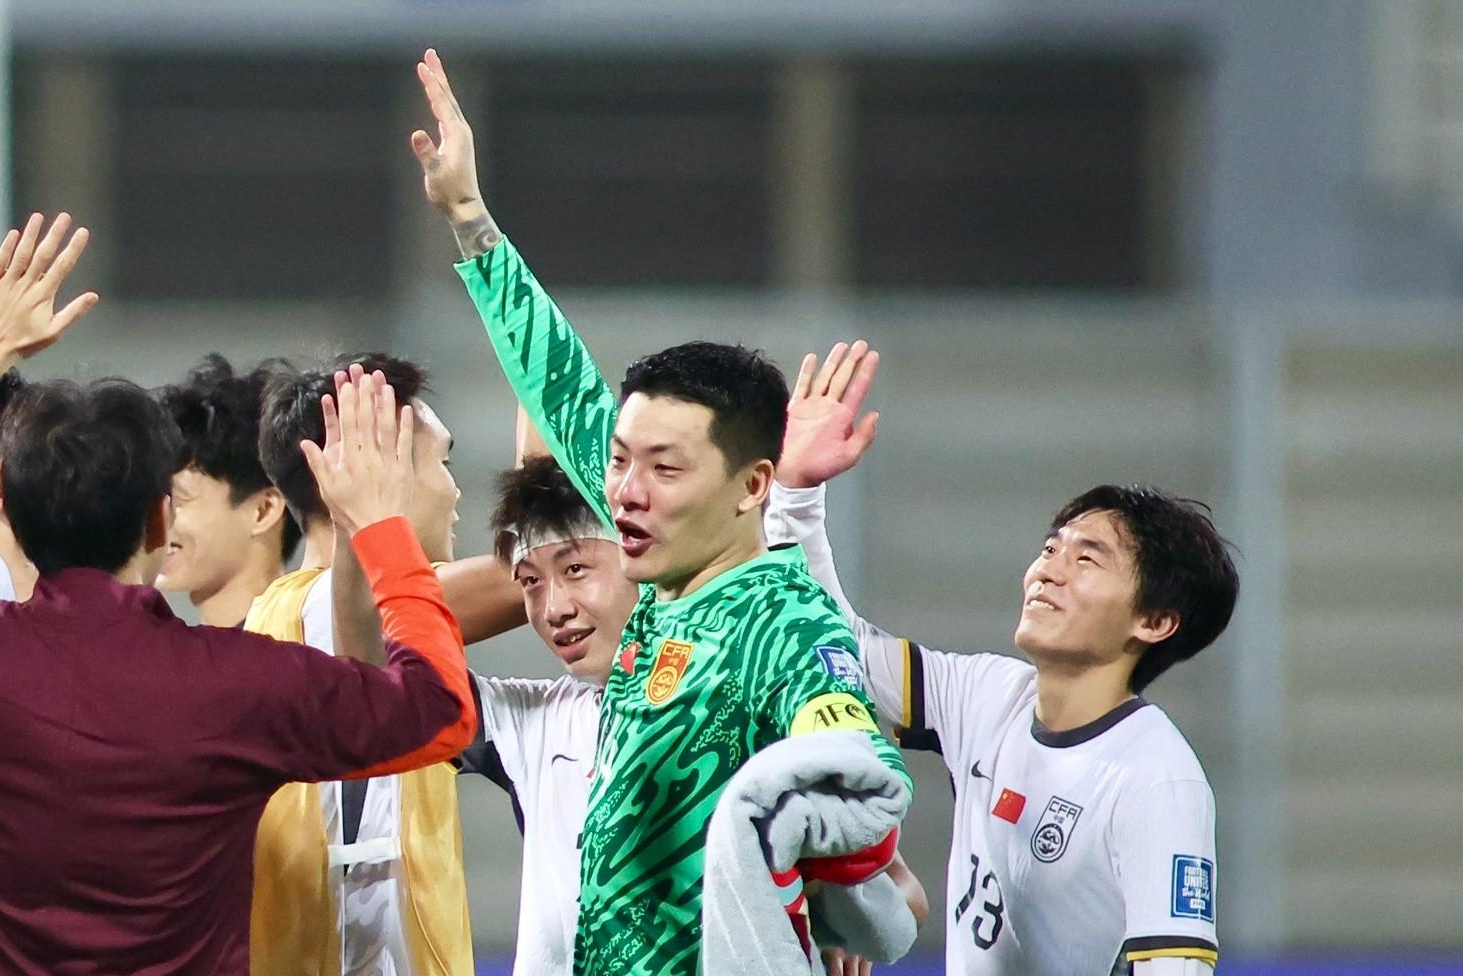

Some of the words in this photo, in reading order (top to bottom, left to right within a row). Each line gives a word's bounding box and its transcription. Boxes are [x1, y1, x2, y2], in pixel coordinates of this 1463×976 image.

[662, 643, 691, 659] CFA
[1048, 800, 1078, 820] CFA
[955, 853, 1004, 951] 13
